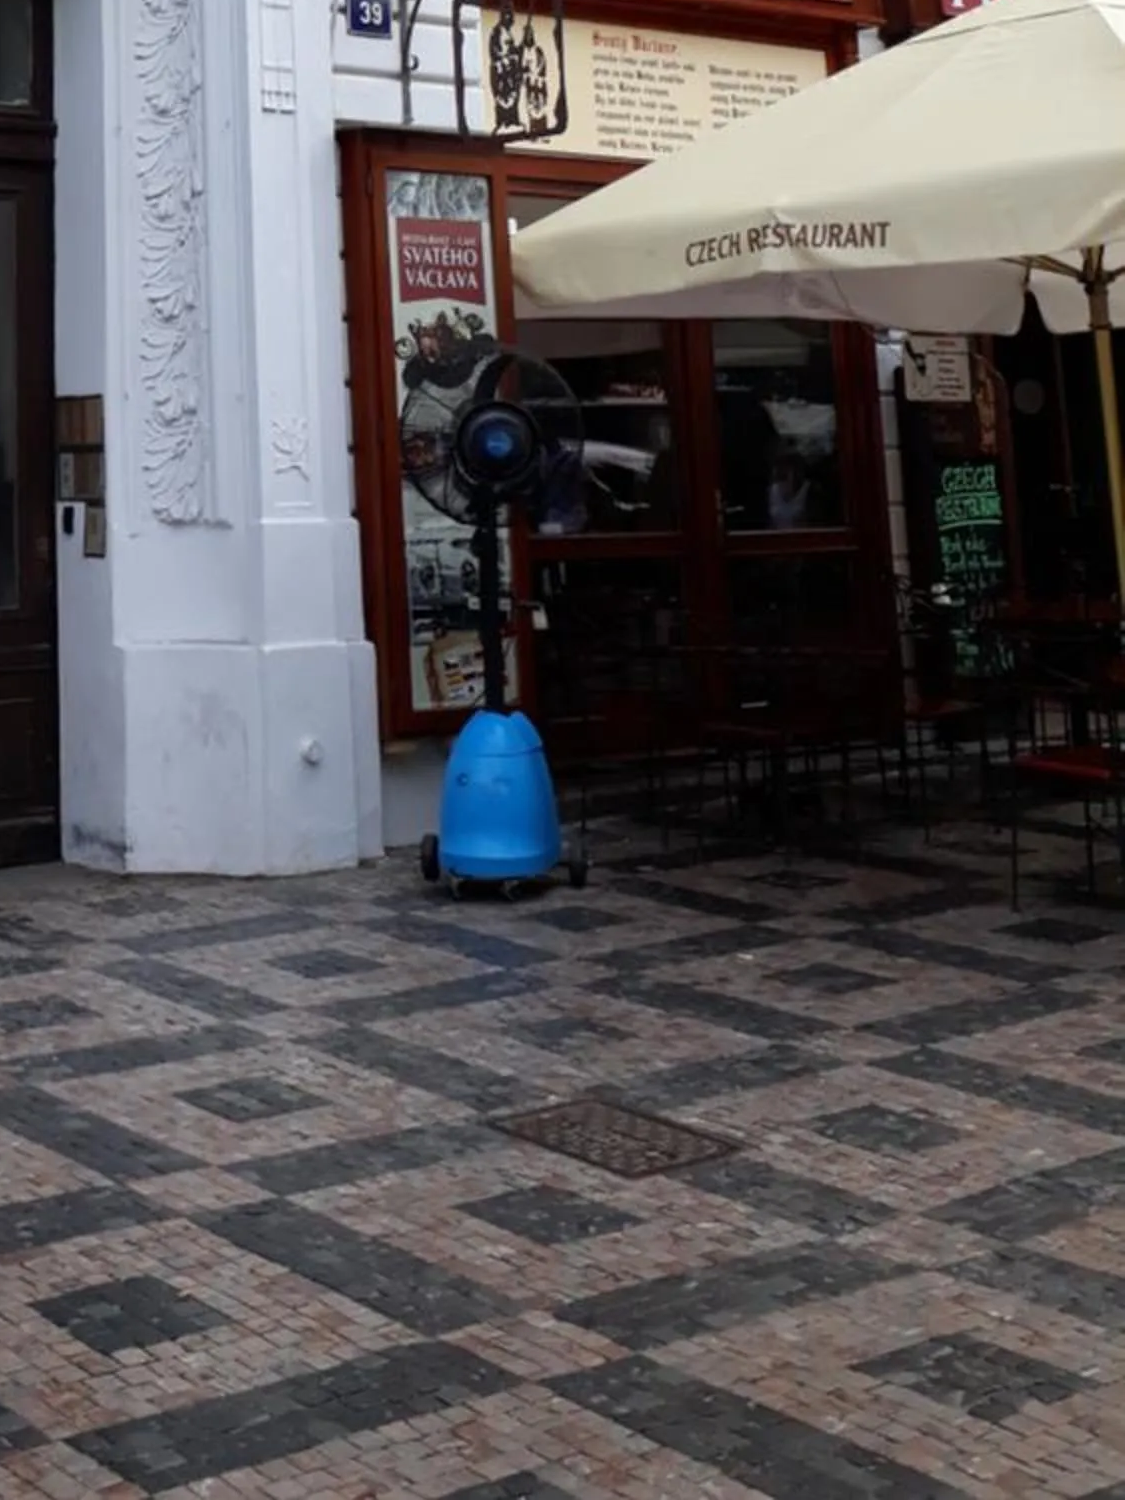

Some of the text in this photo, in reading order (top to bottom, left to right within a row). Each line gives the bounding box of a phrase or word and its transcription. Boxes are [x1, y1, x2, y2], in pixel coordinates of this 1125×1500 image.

[358, 0, 383, 26] 39
[402, 244, 479, 268] SVATÉHO
[684, 221, 892, 268] CZECH RESTAURANT
